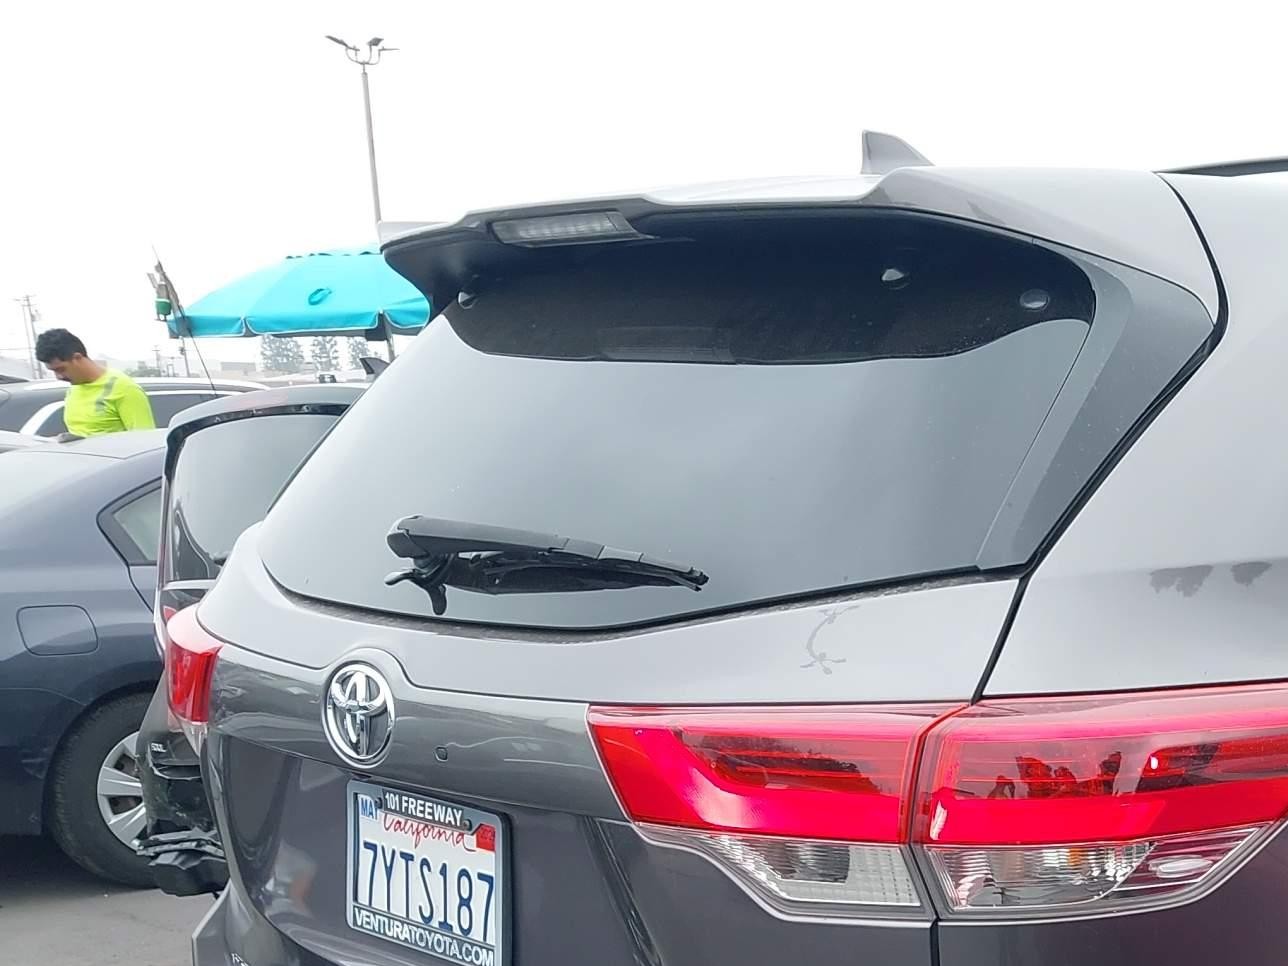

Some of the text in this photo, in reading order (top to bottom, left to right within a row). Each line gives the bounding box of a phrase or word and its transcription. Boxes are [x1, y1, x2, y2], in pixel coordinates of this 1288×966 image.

[385, 791, 463, 827] 101 FREEWAY
[363, 840, 495, 943] 7YTS187
